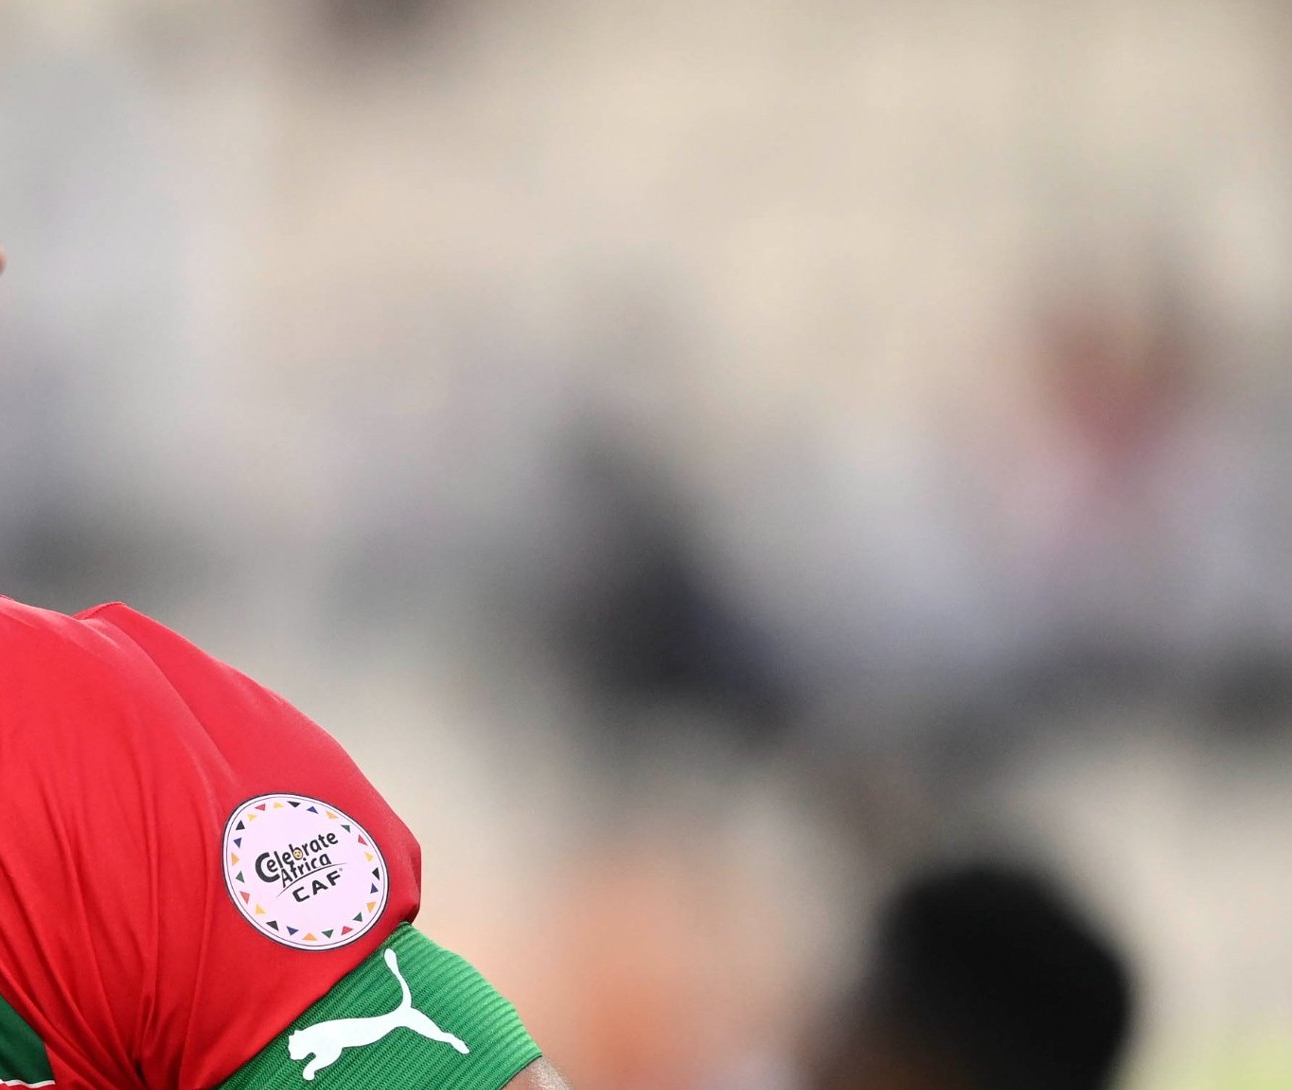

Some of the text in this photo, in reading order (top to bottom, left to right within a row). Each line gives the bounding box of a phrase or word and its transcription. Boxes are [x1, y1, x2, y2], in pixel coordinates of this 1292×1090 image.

[255, 832, 338, 883] Celebrate
[280, 853, 332, 888] Africa
[292, 870, 341, 903] CAF
